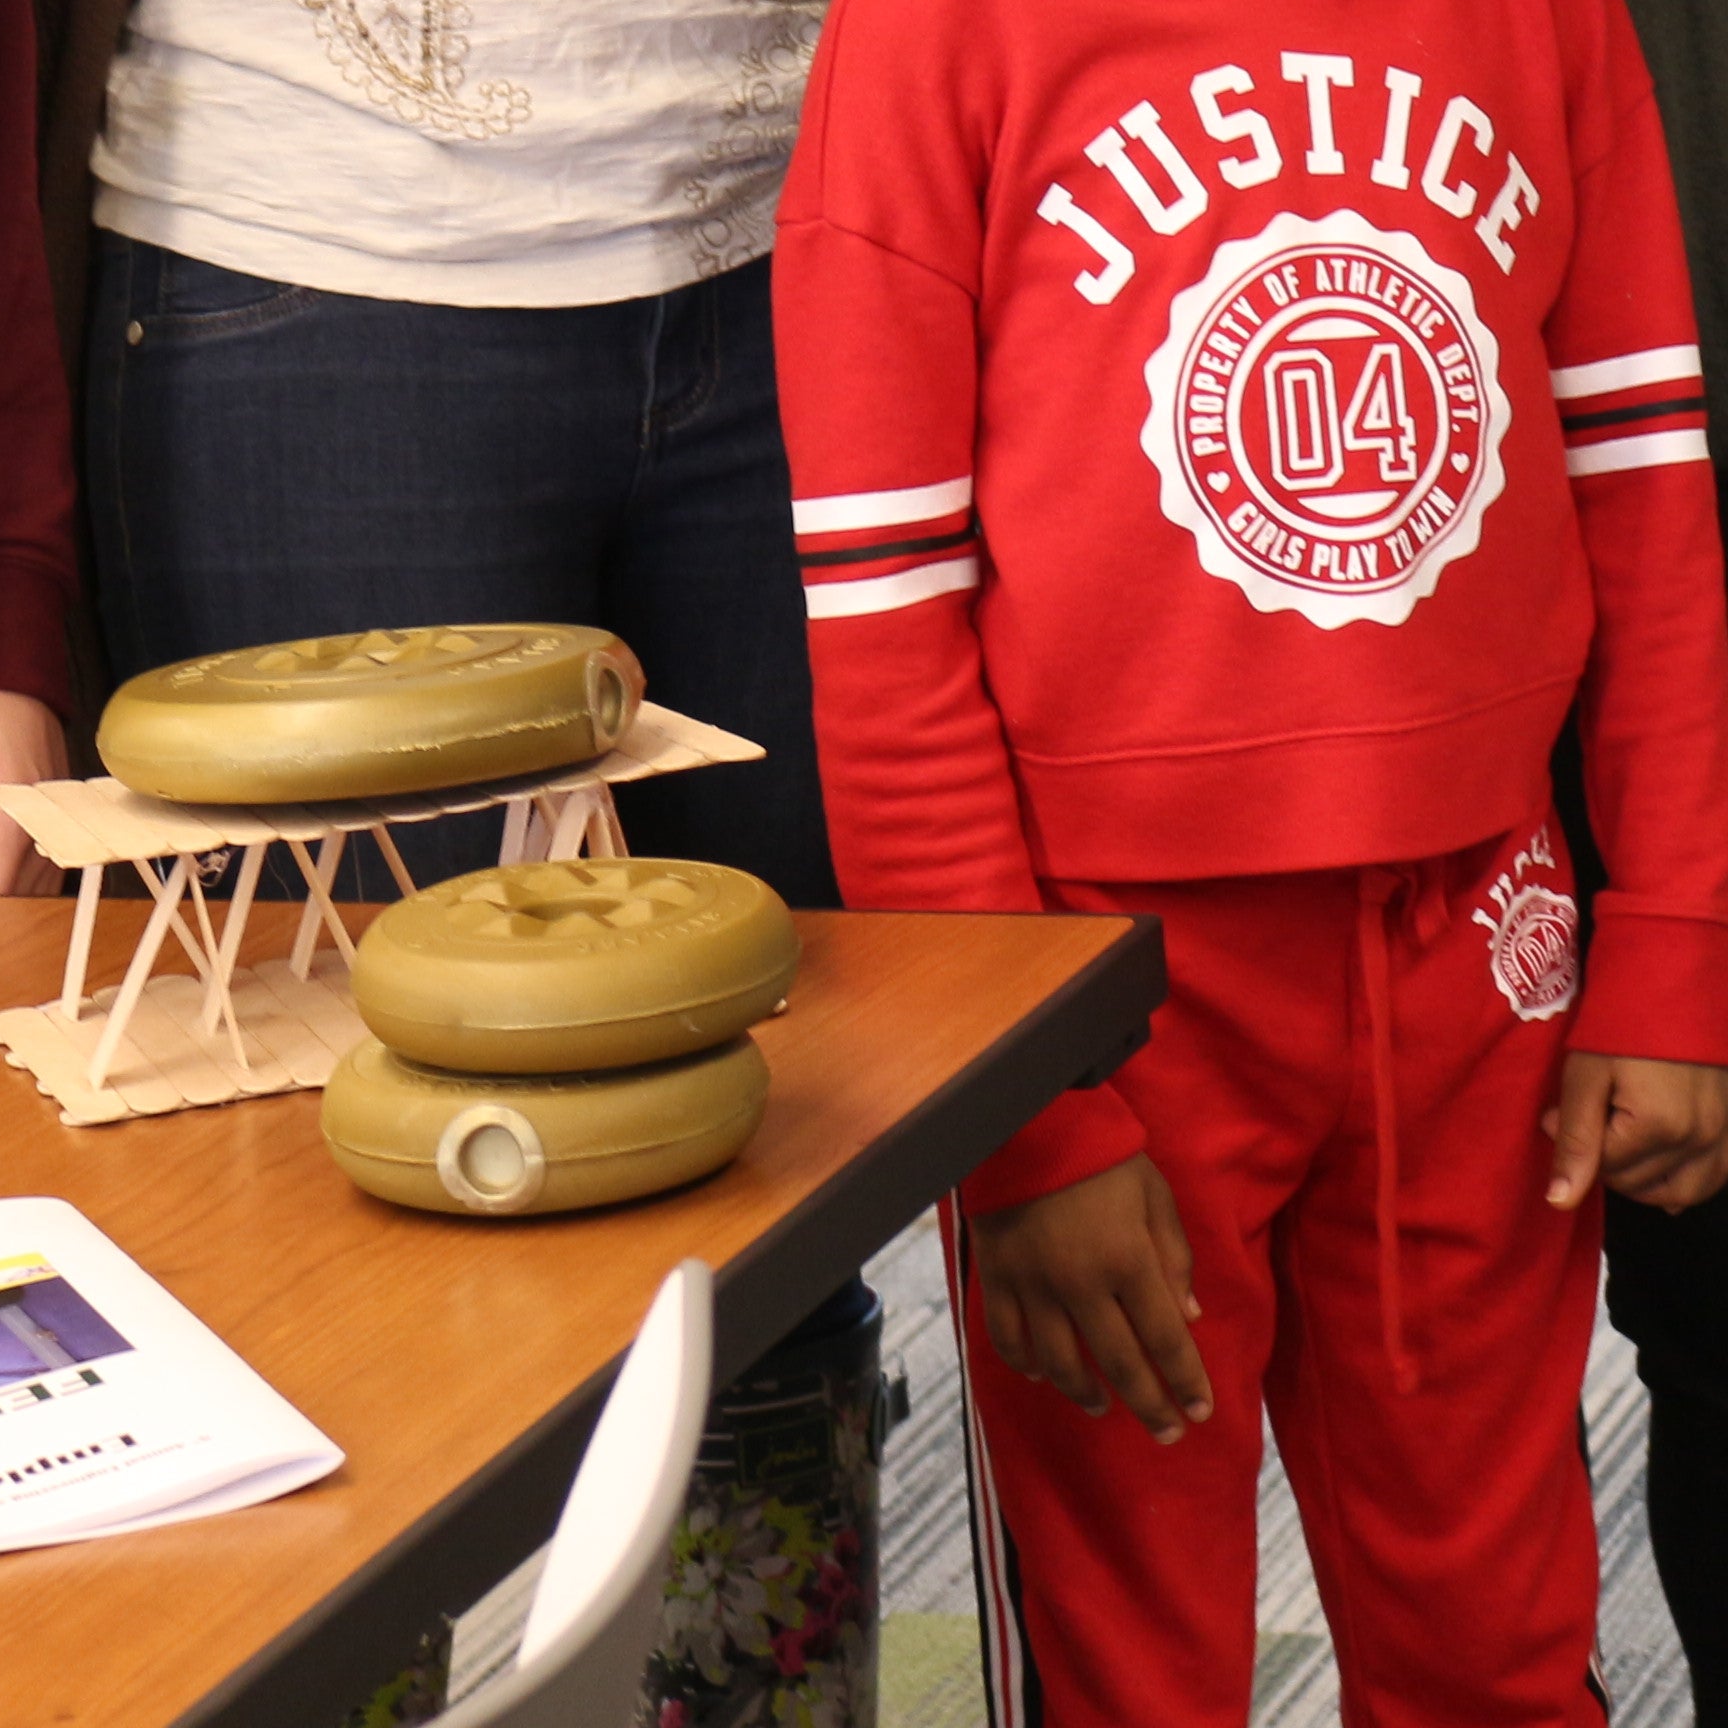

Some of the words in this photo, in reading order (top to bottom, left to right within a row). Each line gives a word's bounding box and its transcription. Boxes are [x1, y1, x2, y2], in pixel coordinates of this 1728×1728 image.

[1037, 50, 1541, 306] JUSTICE
[1188, 300, 1262, 459] PROPERTY
[1264, 263, 1302, 307] OF
[1315, 257, 1446, 338] ATHLETIC
[1263, 343, 1418, 491] 04
[1226, 500, 1304, 571] GIRLS
[1310, 542, 1381, 582] PLAY
[1388, 534, 1417, 578] TO
[1411, 485, 1458, 546] WIN
